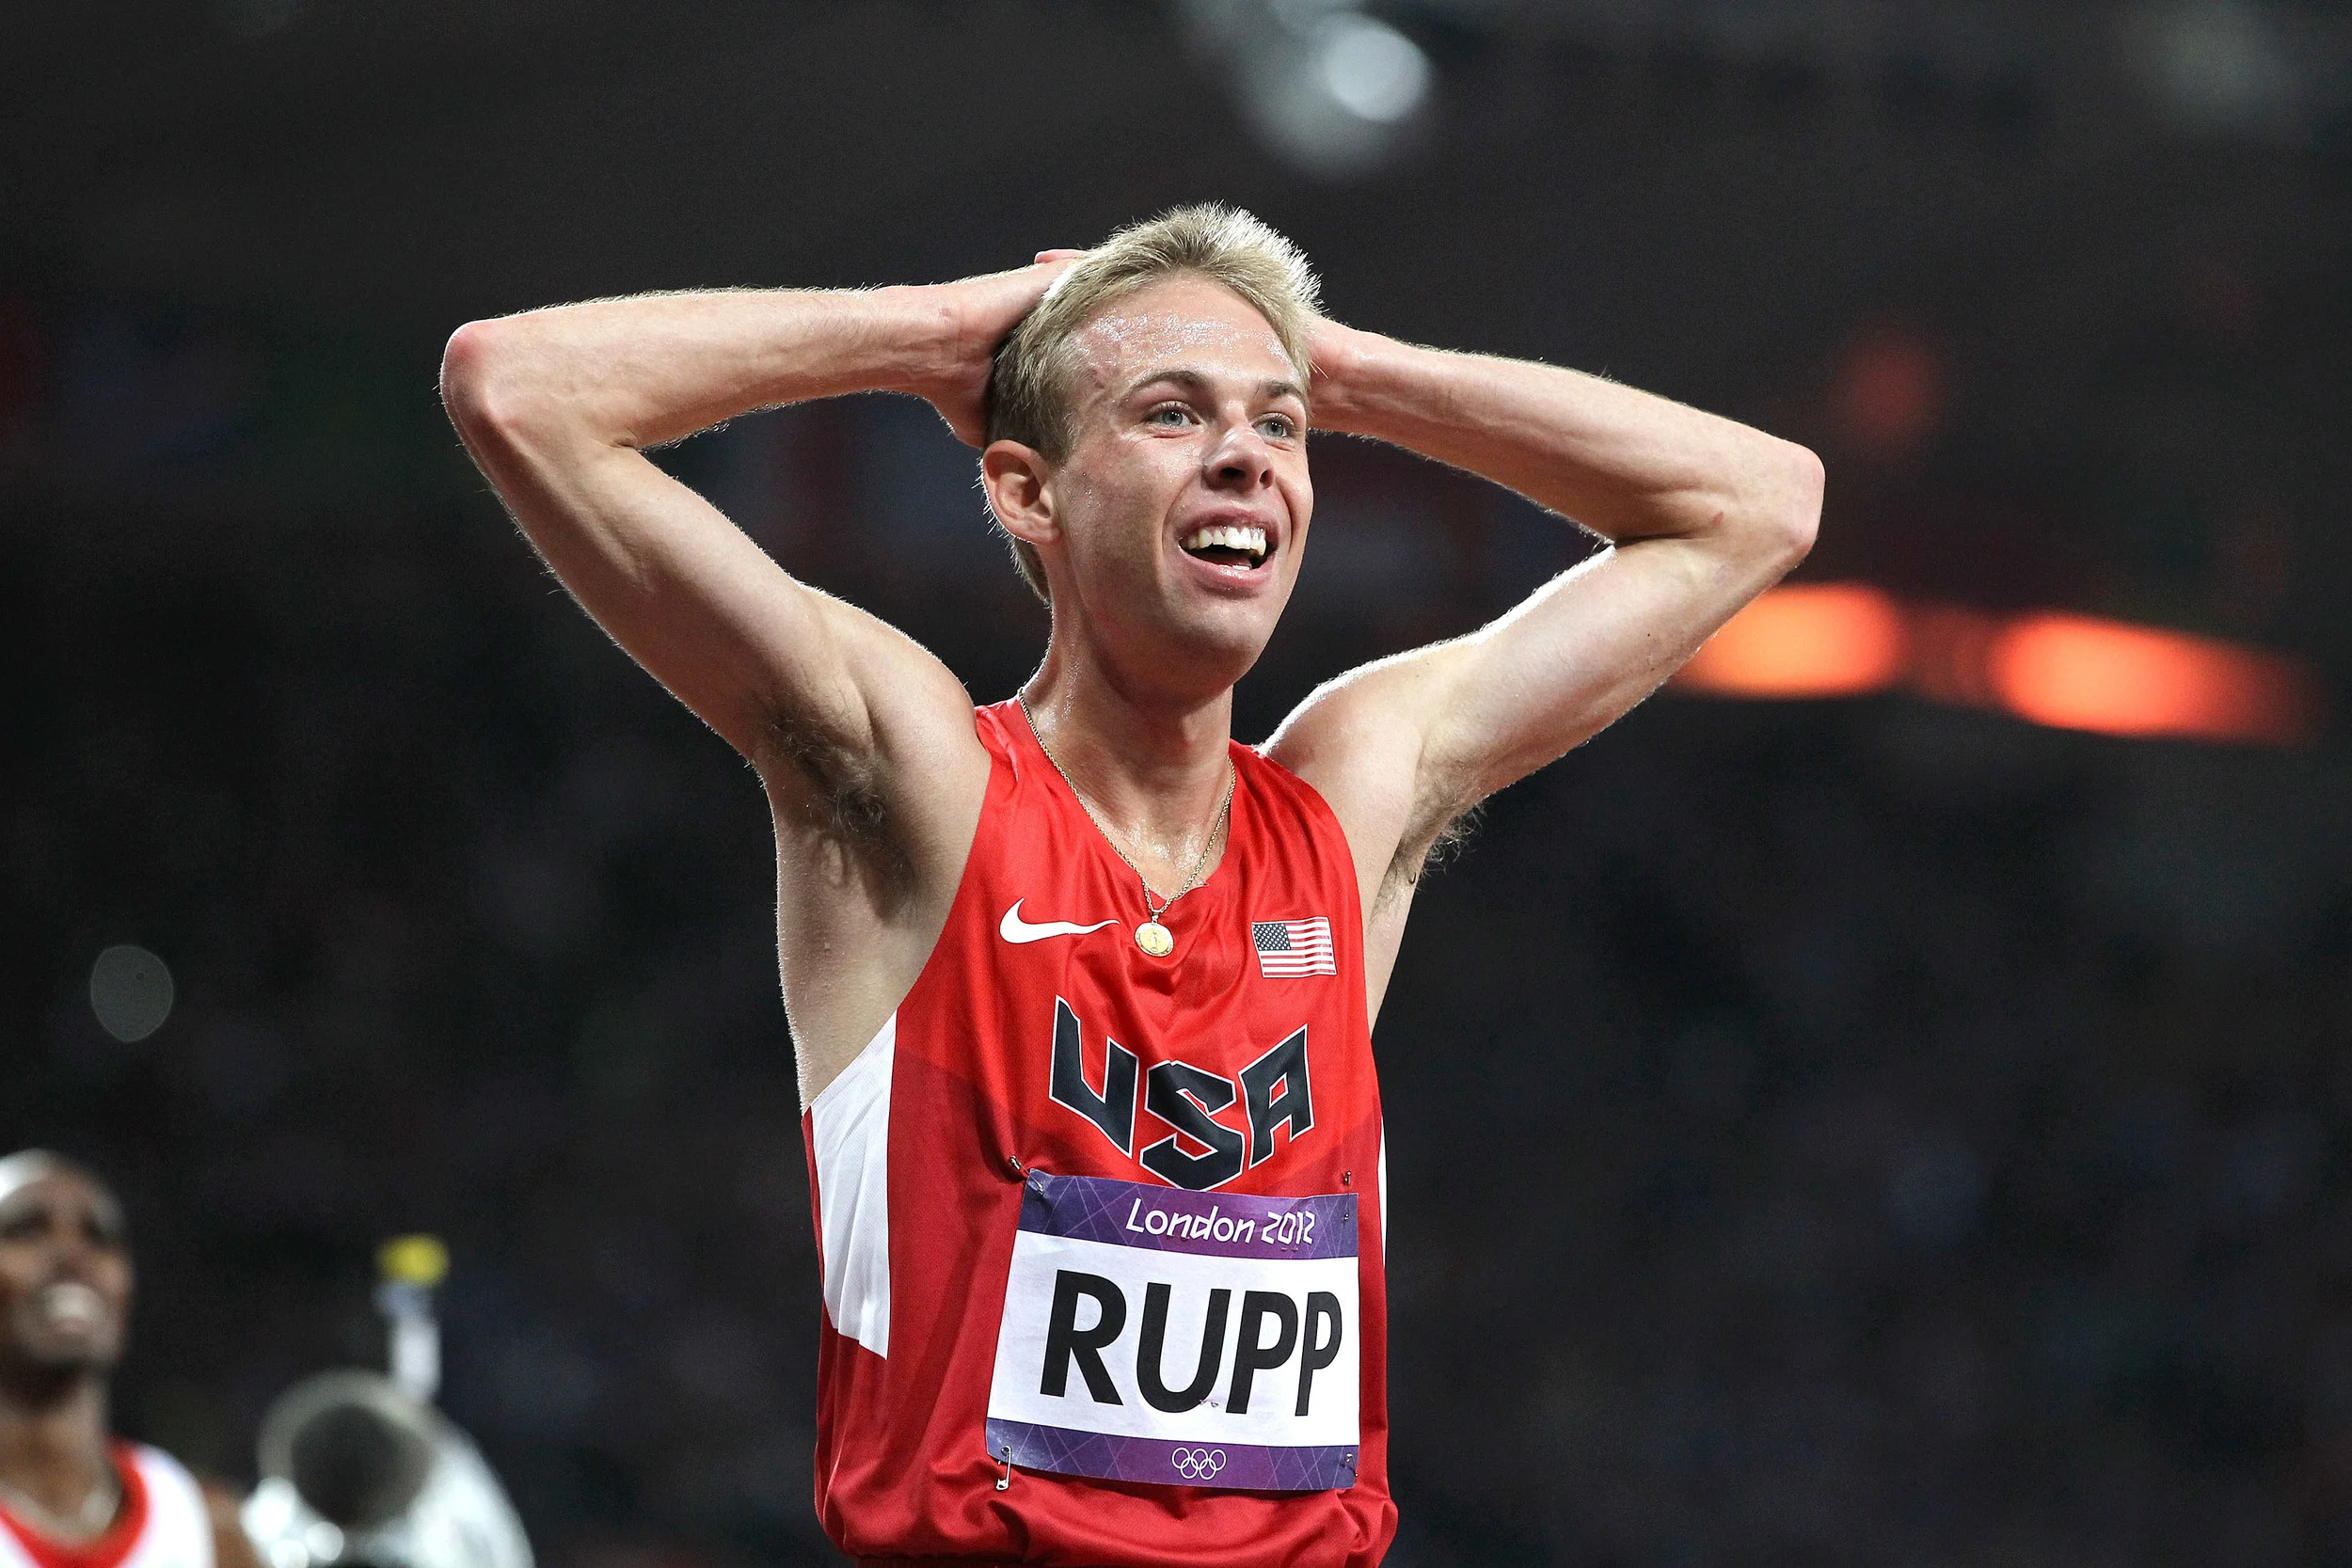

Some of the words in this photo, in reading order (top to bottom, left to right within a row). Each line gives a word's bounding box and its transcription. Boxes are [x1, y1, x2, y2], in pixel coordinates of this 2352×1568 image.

[1049, 994, 1315, 1192] USA
[1125, 1197, 1256, 1243] London
[1261, 1210, 1316, 1245] 2012
[1040, 1269, 1343, 1417] RUPP
